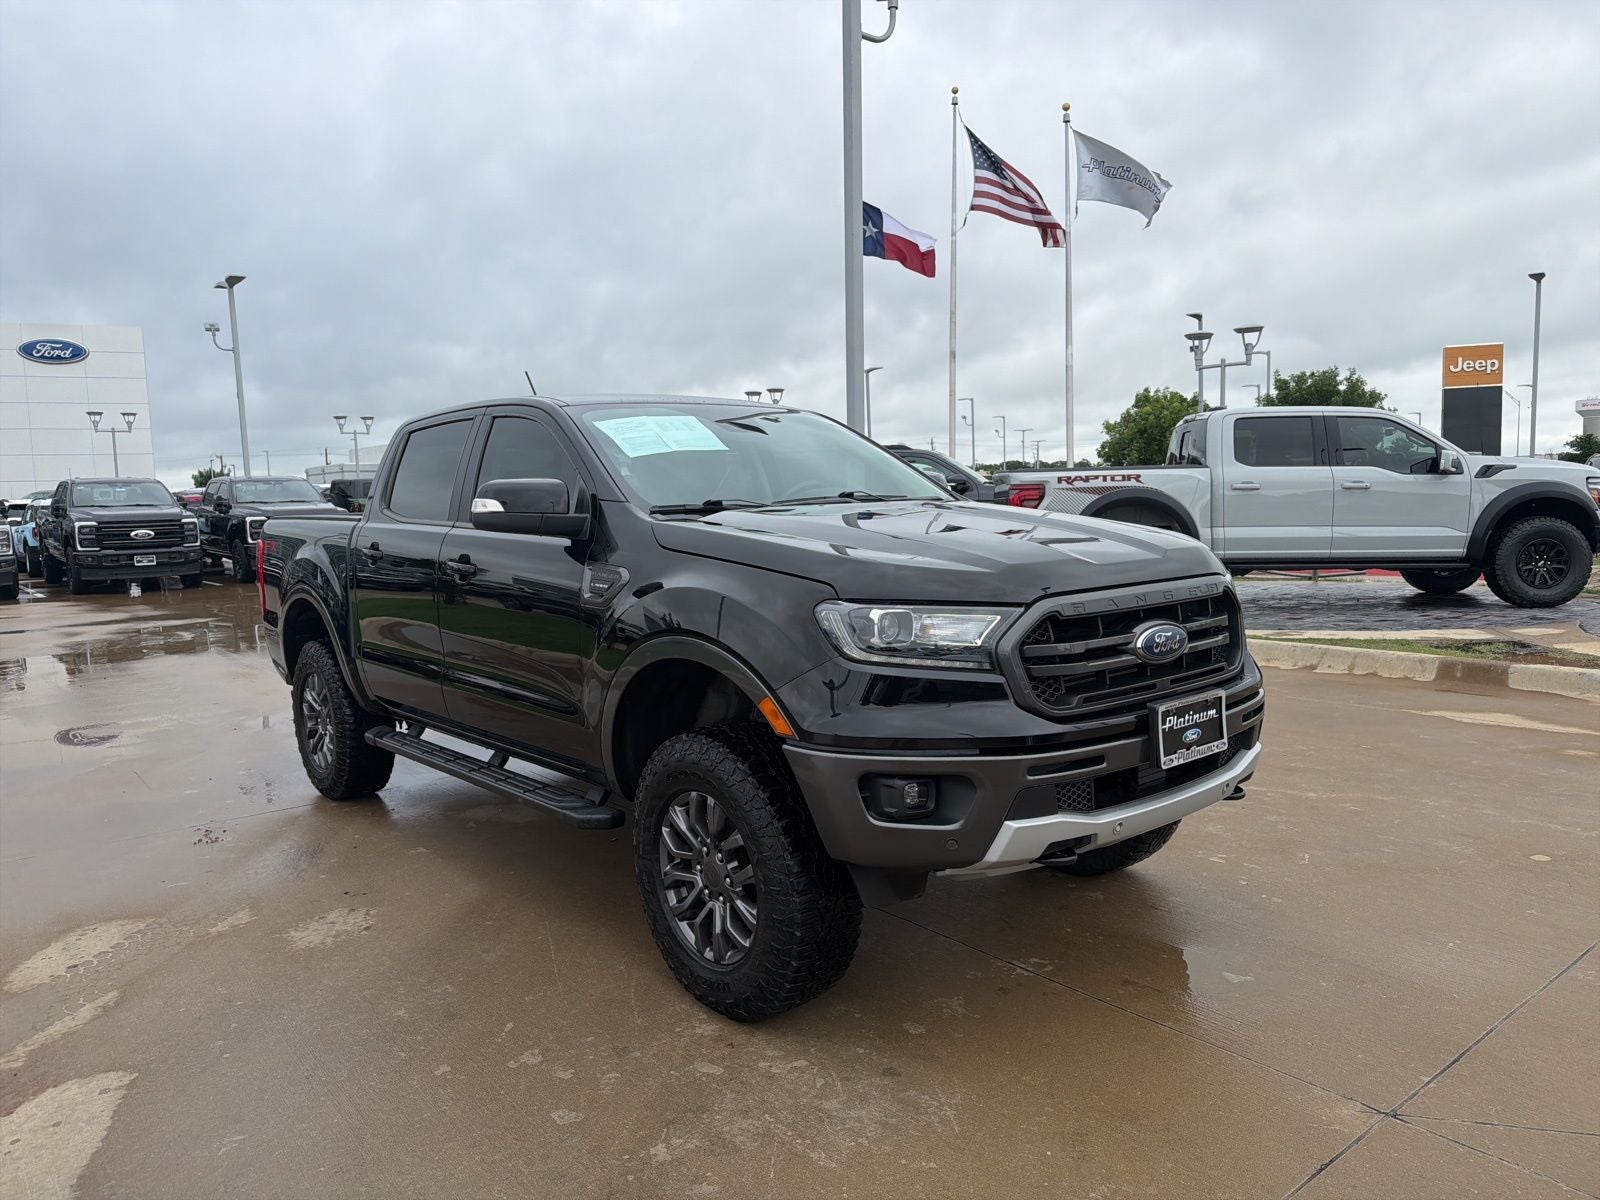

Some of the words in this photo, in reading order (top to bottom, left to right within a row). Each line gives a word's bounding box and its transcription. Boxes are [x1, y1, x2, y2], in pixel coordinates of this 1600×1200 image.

[1082, 157, 1161, 203] Platinum
[32, 342, 73, 358] Ford
[1450, 357, 1499, 373] Jeep
[1057, 474, 1144, 486] RAPTOR
[1153, 631, 1181, 653] Ford
[1162, 708, 1219, 732] Platinum
